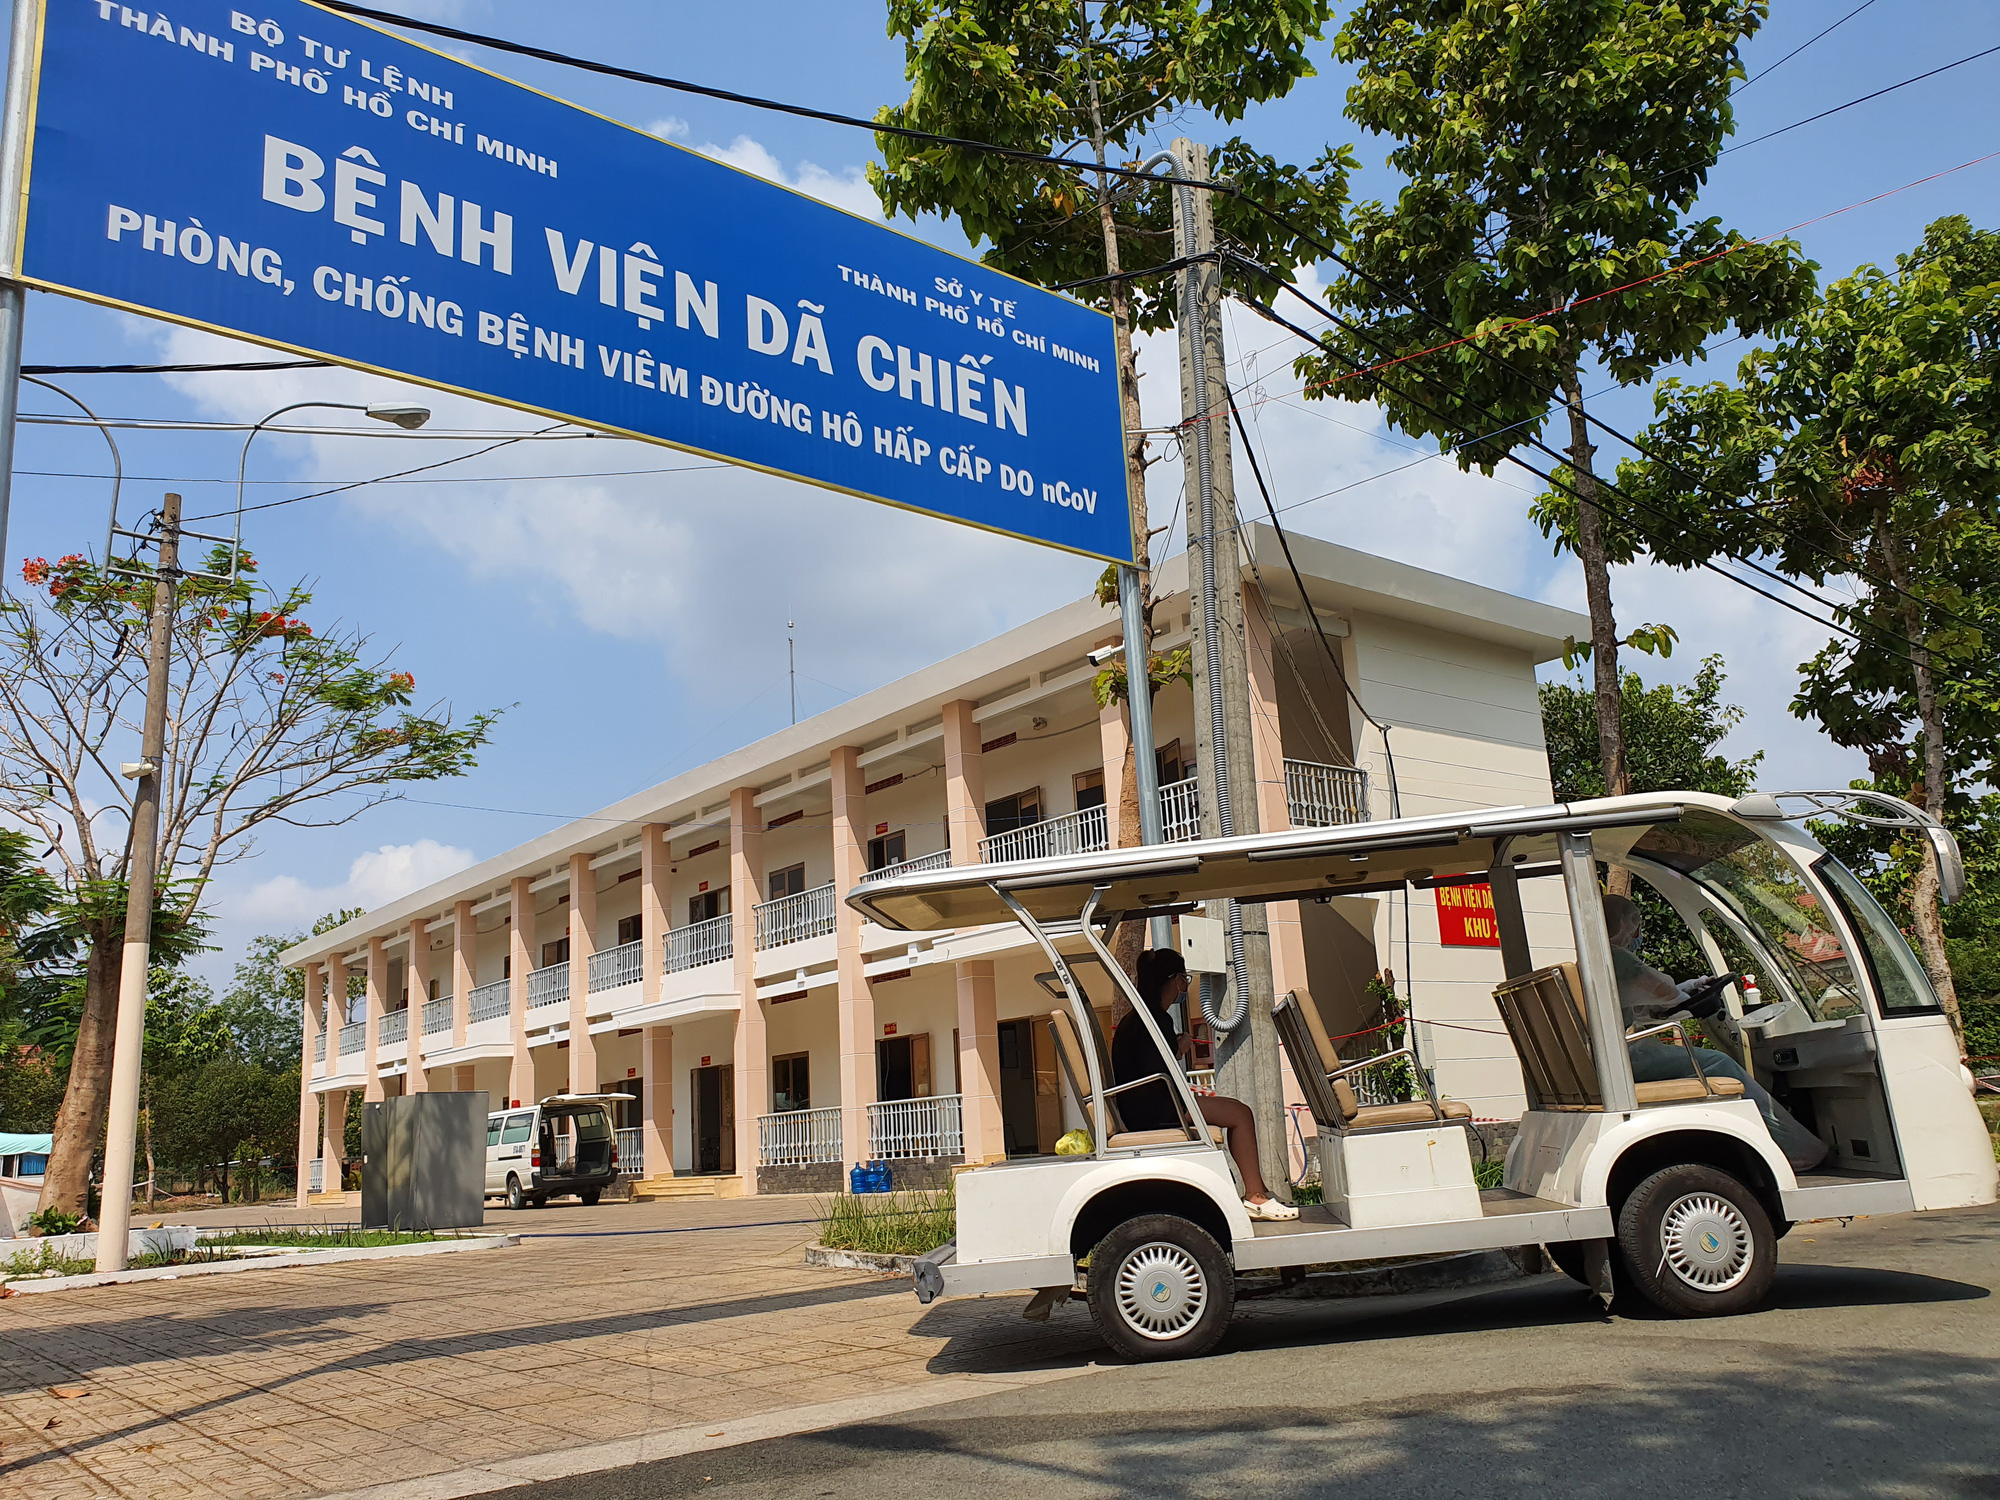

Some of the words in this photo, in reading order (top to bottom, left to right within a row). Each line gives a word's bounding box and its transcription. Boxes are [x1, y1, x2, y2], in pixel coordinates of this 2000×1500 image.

[92, 0, 234, 63] THÀNH
[250, 51, 333, 94] PHỐ
[343, 85, 393, 118] HỒ
[406, 110, 466, 145] CHÍ
[476, 133, 558, 179] MINH
[231, 10, 285, 48] BỘ
[298, 35, 352, 69] TƯ
[361, 59, 453, 110] LỆNH
[262, 133, 513, 276] BỆNH
[544, 227, 719, 339] VIỆN
[746, 294, 834, 375] DÃ
[857, 334, 1028, 437] CHIẾN
[837, 264, 917, 307] THÀNH
[924, 296, 970, 324] PHỐ
[976, 315, 1005, 337] HỒ
[1012, 329, 1046, 353] CHÍ
[1052, 343, 1100, 374] MINH
[934, 277, 964, 298] SỞ
[969, 289, 983, 306] Y
[989, 296, 1018, 319] TẾ
[107, 204, 295, 296] PHÒNG,
[313, 265, 464, 337] CHỐNG
[478, 310, 585, 370] BỆNH
[598, 344, 689, 399] VIÊM
[700, 374, 812, 435] ĐƯỜNG
[822, 410, 863, 447] HÔ
[873, 425, 931, 466] HẤP
[939, 444, 992, 483] CẤP
[999, 463, 1034, 497] DO
[1042, 481, 1097, 515] nCoV
[1462, 883, 1482, 912] VIỆN
[1463, 916, 1491, 939] KHU
